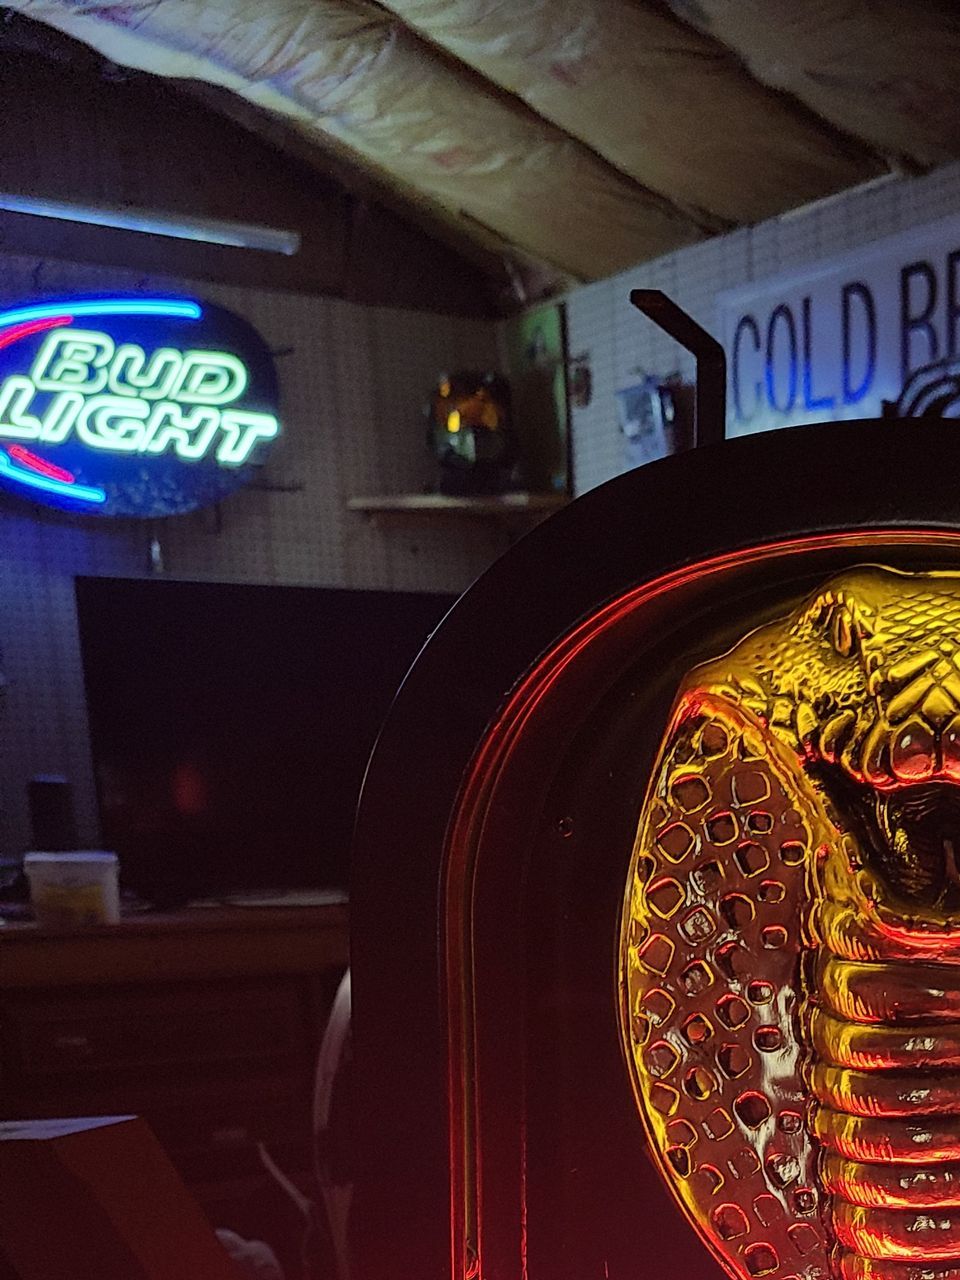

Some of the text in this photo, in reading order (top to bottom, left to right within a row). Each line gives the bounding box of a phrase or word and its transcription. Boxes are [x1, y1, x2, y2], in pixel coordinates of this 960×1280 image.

[33, 328, 248, 406] BUD
[730, 280, 877, 420] COLD
[0, 376, 280, 467] LIGHT
